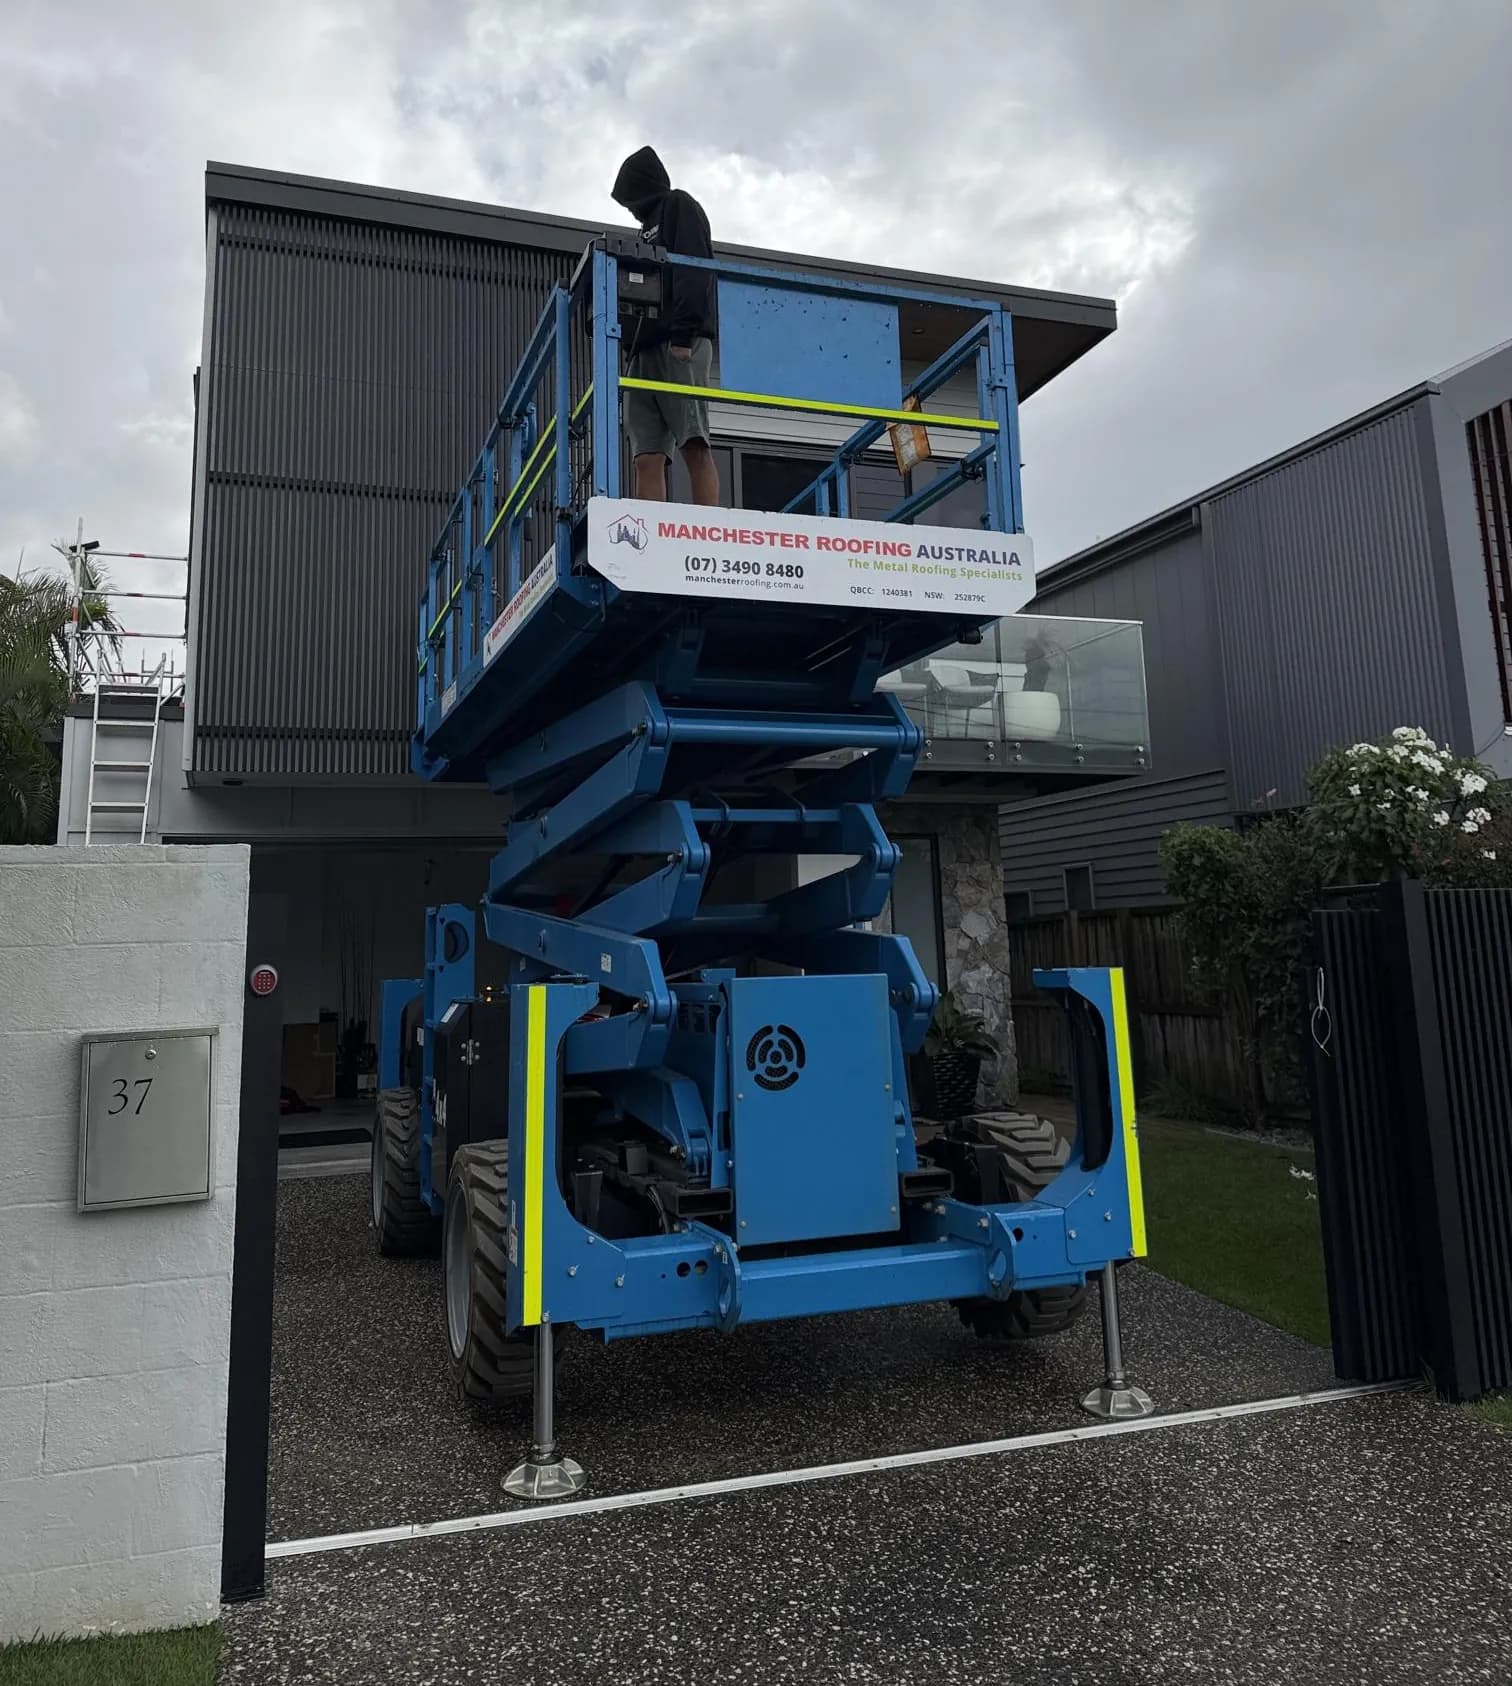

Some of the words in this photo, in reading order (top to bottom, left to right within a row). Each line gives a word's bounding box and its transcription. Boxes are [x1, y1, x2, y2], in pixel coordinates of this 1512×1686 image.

[658, 522, 810, 549] MANCHESTER
[816, 536, 912, 557] ROOFING
[916, 544, 1021, 566] AUSTRALIA
[684, 555, 717, 574] (07)
[722, 559, 761, 576] 3490
[765, 562, 804, 578] 8480
[848, 558, 870, 570] The
[873, 560, 908, 573] Metal
[912, 563, 957, 578] Roofing
[960, 567, 1023, 581] Specialists
[685, 574, 805, 590] manchesterroofing.com.au
[850, 586, 875, 596] QBCC:
[881, 588, 913, 598] 1240381
[924, 590, 945, 600] NSW:
[954, 593, 986, 603] 252879C
[107, 1078, 153, 1115] 37
